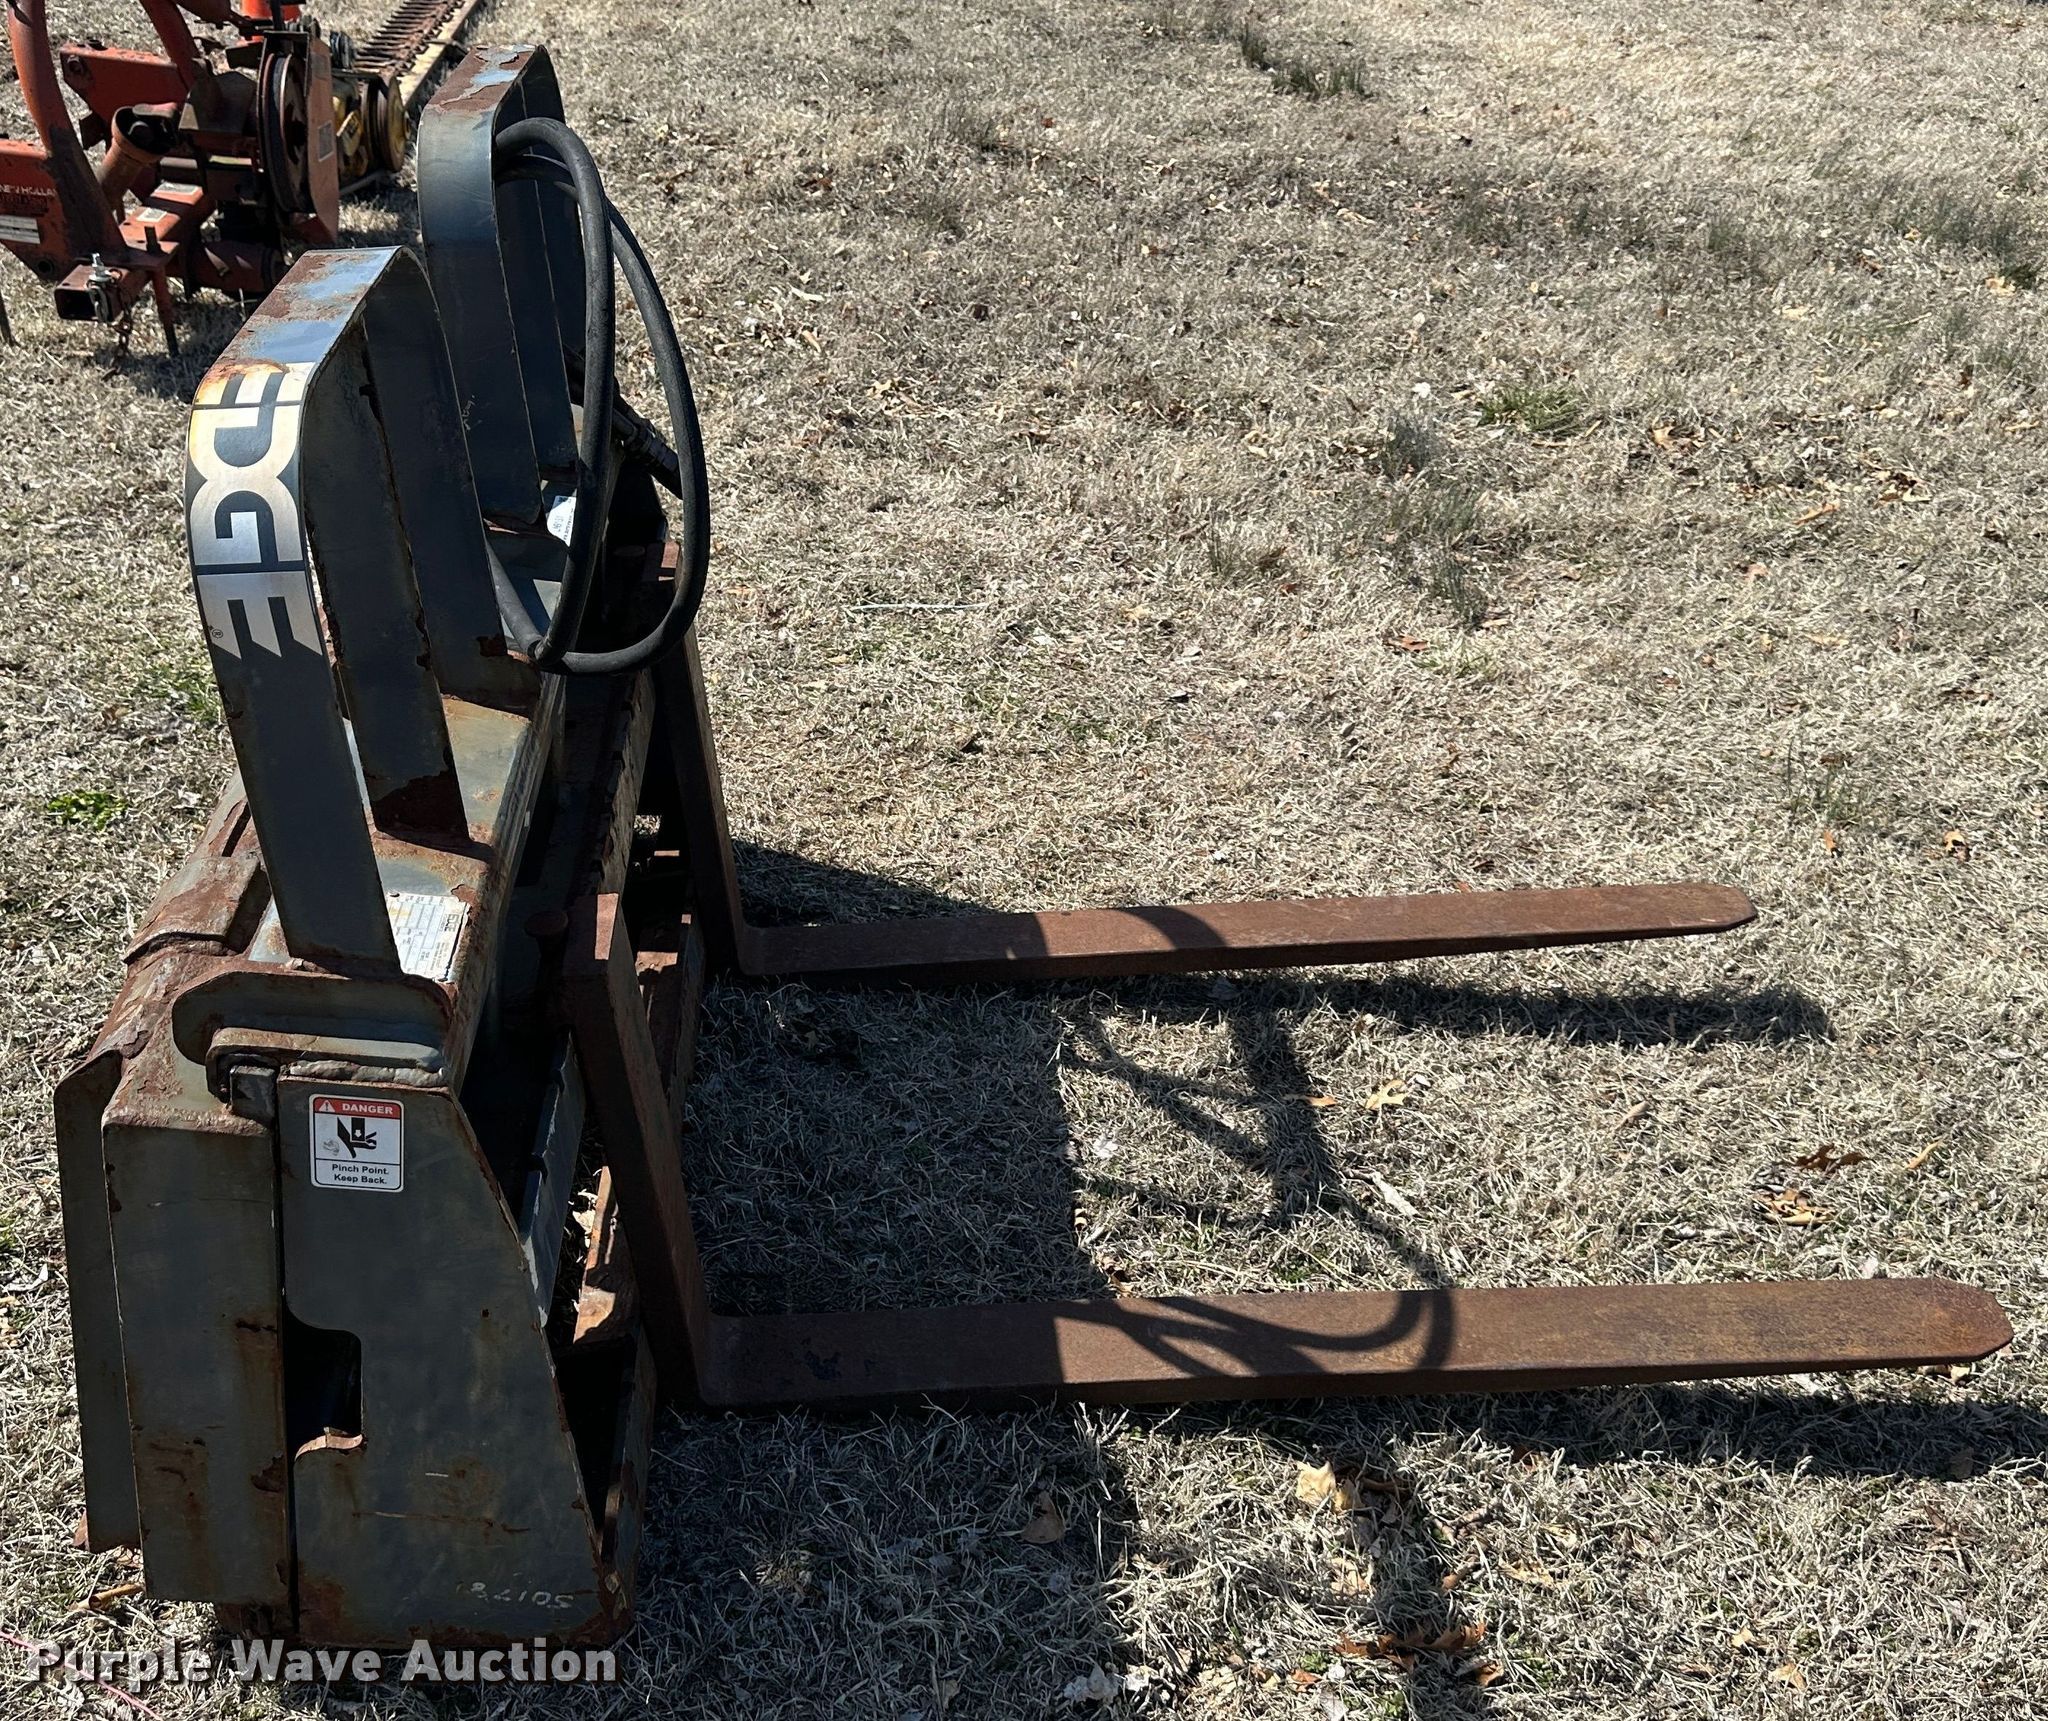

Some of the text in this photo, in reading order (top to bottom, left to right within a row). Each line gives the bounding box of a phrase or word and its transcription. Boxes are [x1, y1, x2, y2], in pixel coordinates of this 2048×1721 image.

[189, 362, 323, 660] EDGE
[342, 1103, 393, 1115] DANGER
[332, 1163, 389, 1175] Pinch Point.
[334, 1173, 388, 1184] Keep Back.
